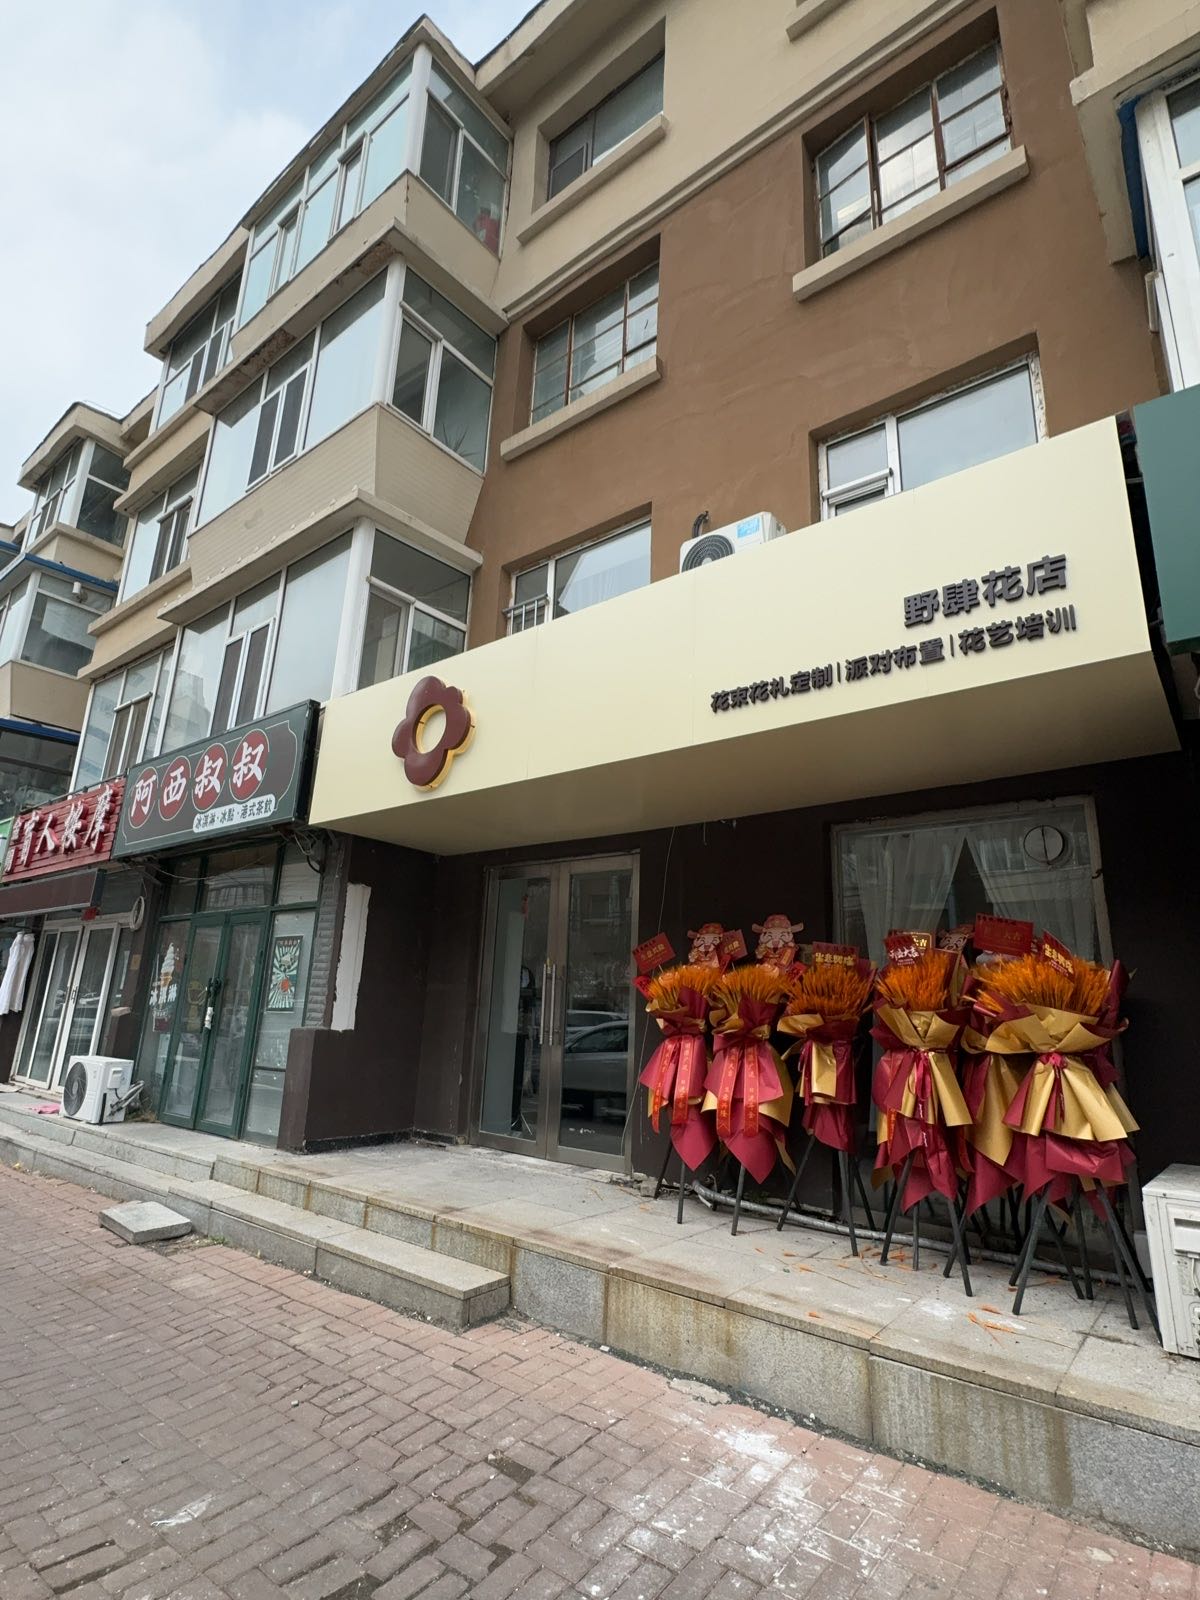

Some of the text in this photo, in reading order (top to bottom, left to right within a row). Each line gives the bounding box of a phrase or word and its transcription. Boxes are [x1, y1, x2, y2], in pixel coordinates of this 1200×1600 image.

[903, 553, 1067, 628] 野肆花店
[131, 742, 264, 817] 阿西叔叔
